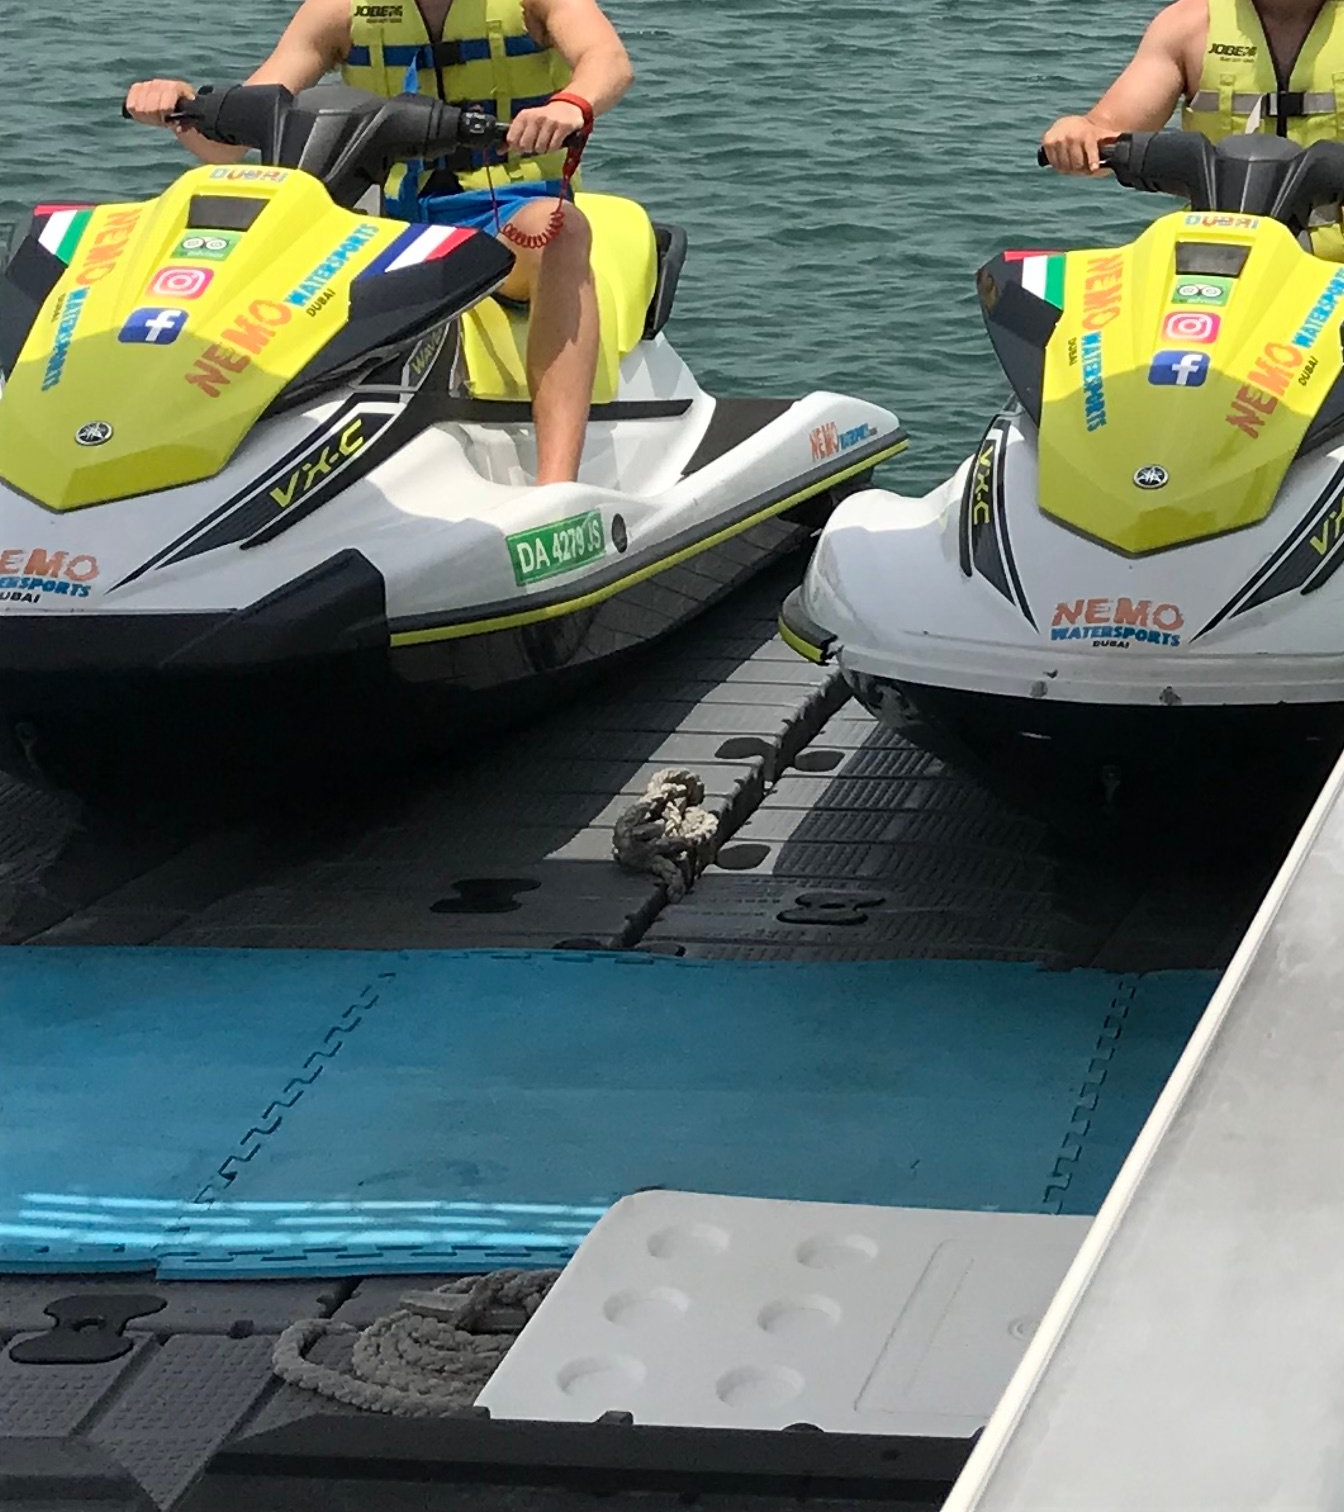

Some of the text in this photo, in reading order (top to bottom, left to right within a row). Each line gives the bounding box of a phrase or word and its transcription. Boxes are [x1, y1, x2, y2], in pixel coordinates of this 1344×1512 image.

[76, 208, 142, 286] NEMO
[284, 223, 380, 309] WATERSPORTS
[305, 288, 336, 318] DUBAI
[1082, 254, 1125, 331] NEMO
[185, 298, 293, 399] NEMO
[1225, 342, 1304, 439] NEMO
[1298, 356, 1319, 386] DUBAI
[269, 418, 366, 509] VX-C
[0, 548, 100, 582] EMO
[516, 520, 602, 574] DA 4279 JS
[0, 591, 42, 603] UBAI
[1051, 597, 1185, 631] NEMO
[1051, 626, 1181, 647] WATERSPORTS
[1092, 640, 1130, 649] DUBAI
